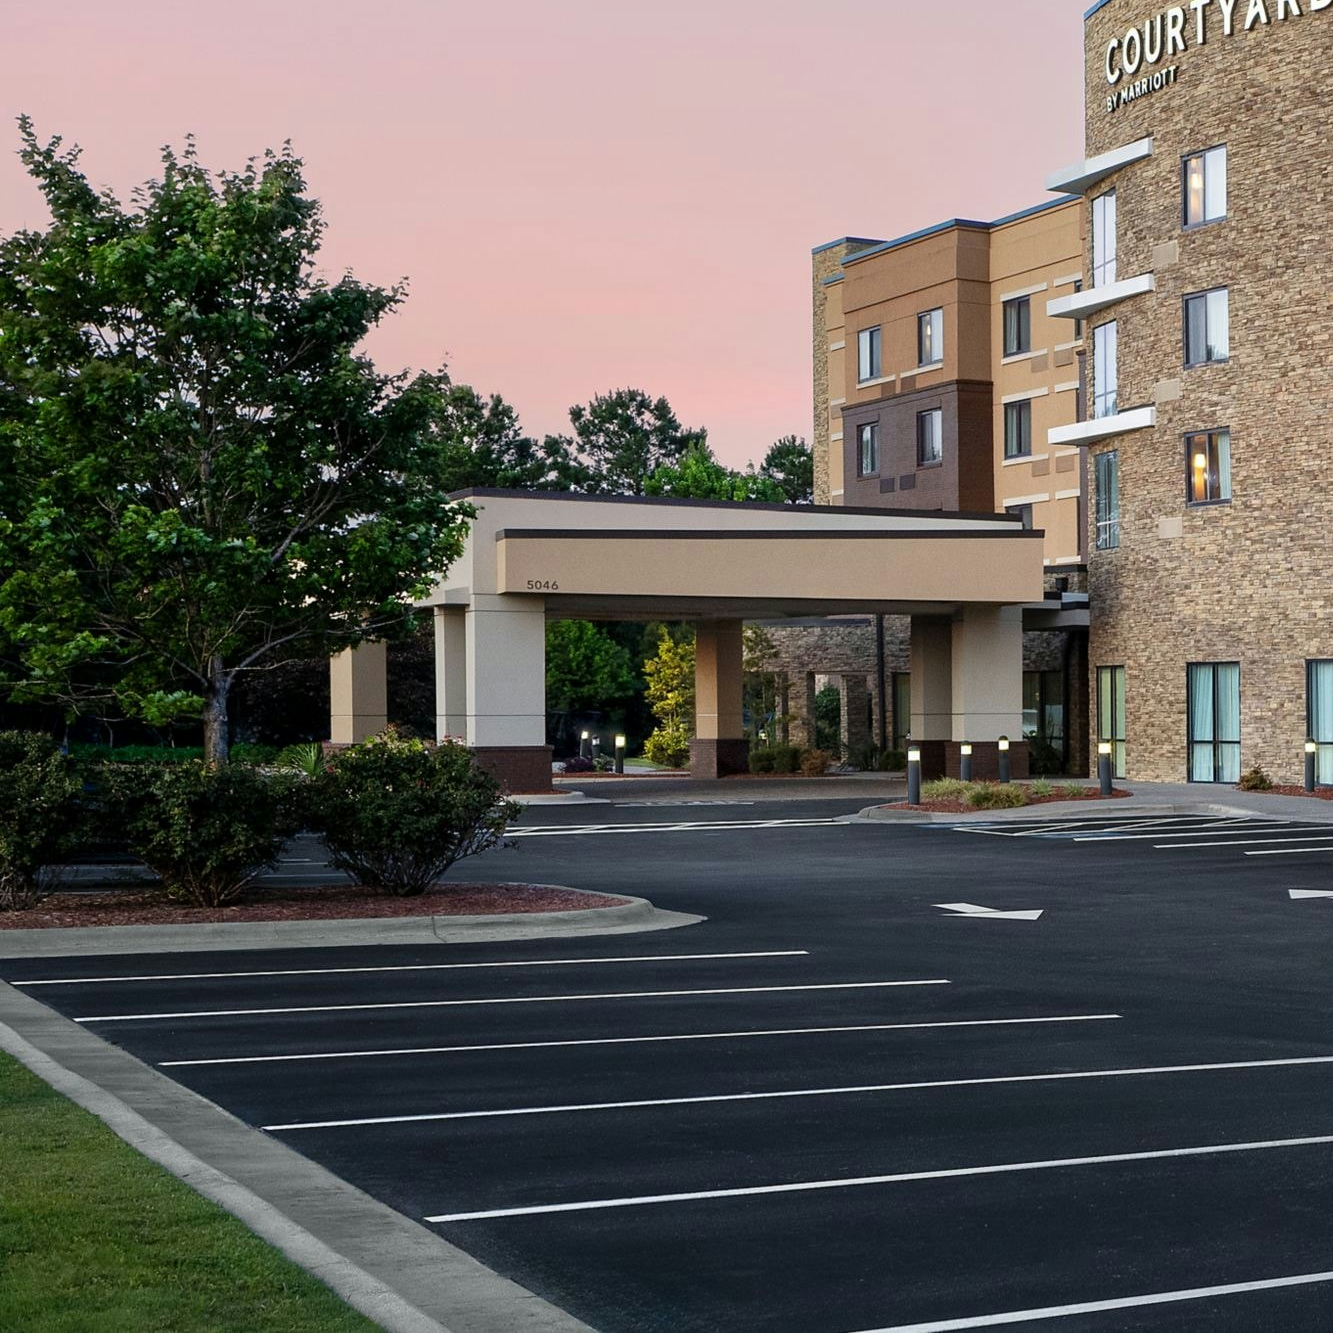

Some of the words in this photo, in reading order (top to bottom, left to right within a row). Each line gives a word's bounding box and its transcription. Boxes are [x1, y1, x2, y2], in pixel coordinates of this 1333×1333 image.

[1106, 92, 1118, 113] BY
[1120, 65, 1177, 104] MARRIOTT
[526, 579, 560, 591] 5046
